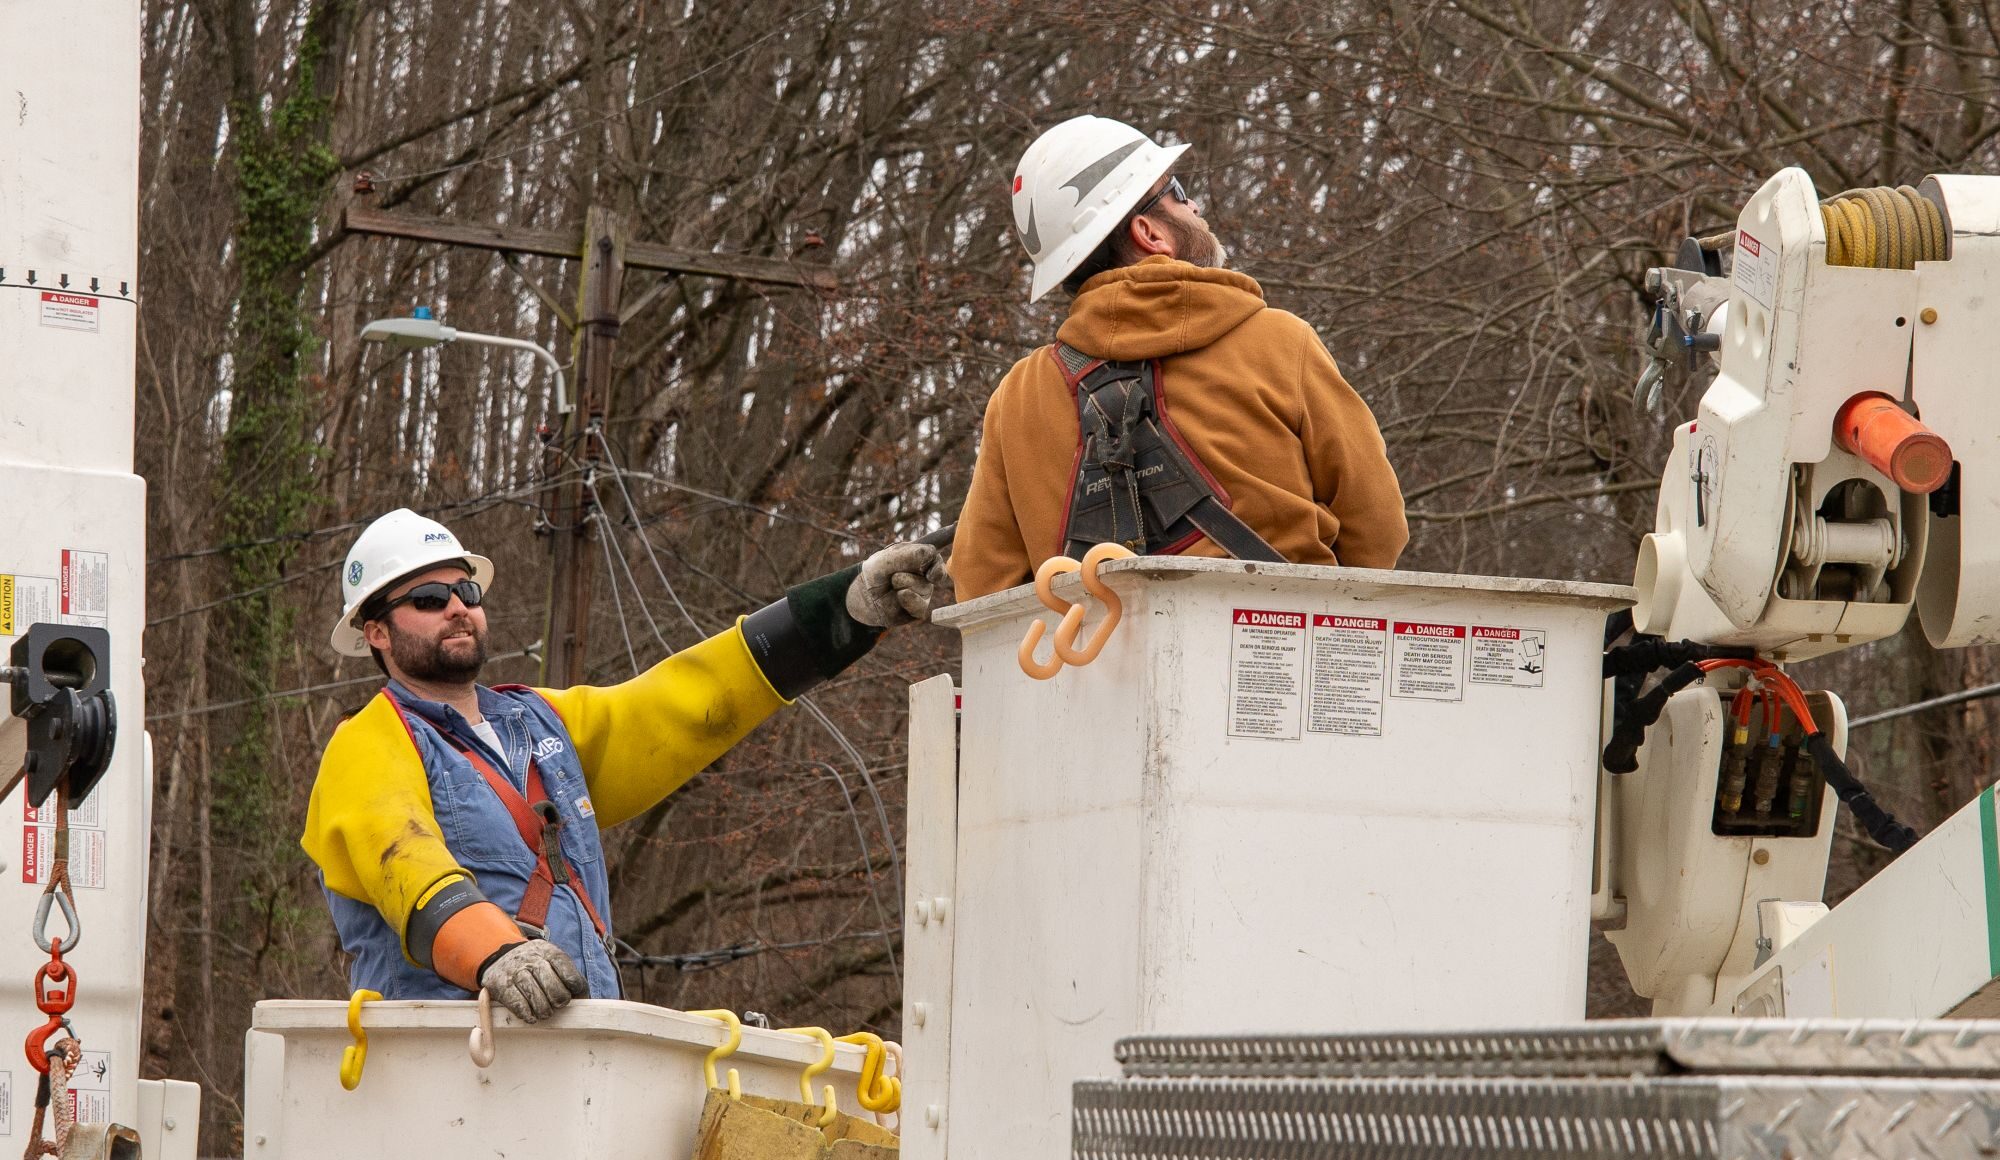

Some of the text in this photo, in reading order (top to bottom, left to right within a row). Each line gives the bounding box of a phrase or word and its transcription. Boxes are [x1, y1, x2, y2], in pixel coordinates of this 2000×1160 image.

[59, 295, 90, 306] DANGER
[3, 578, 12, 620] CAUTION
[1251, 612, 1302, 627] DANGER
[1334, 617, 1379, 629] DANGER
[1416, 625, 1455, 637] DANGER
[1483, 629, 1517, 639] DANGER
[1397, 635, 1440, 643] ELECTROCUTION
[531, 737, 557, 758] MP
[27, 833, 35, 866] DANGER
